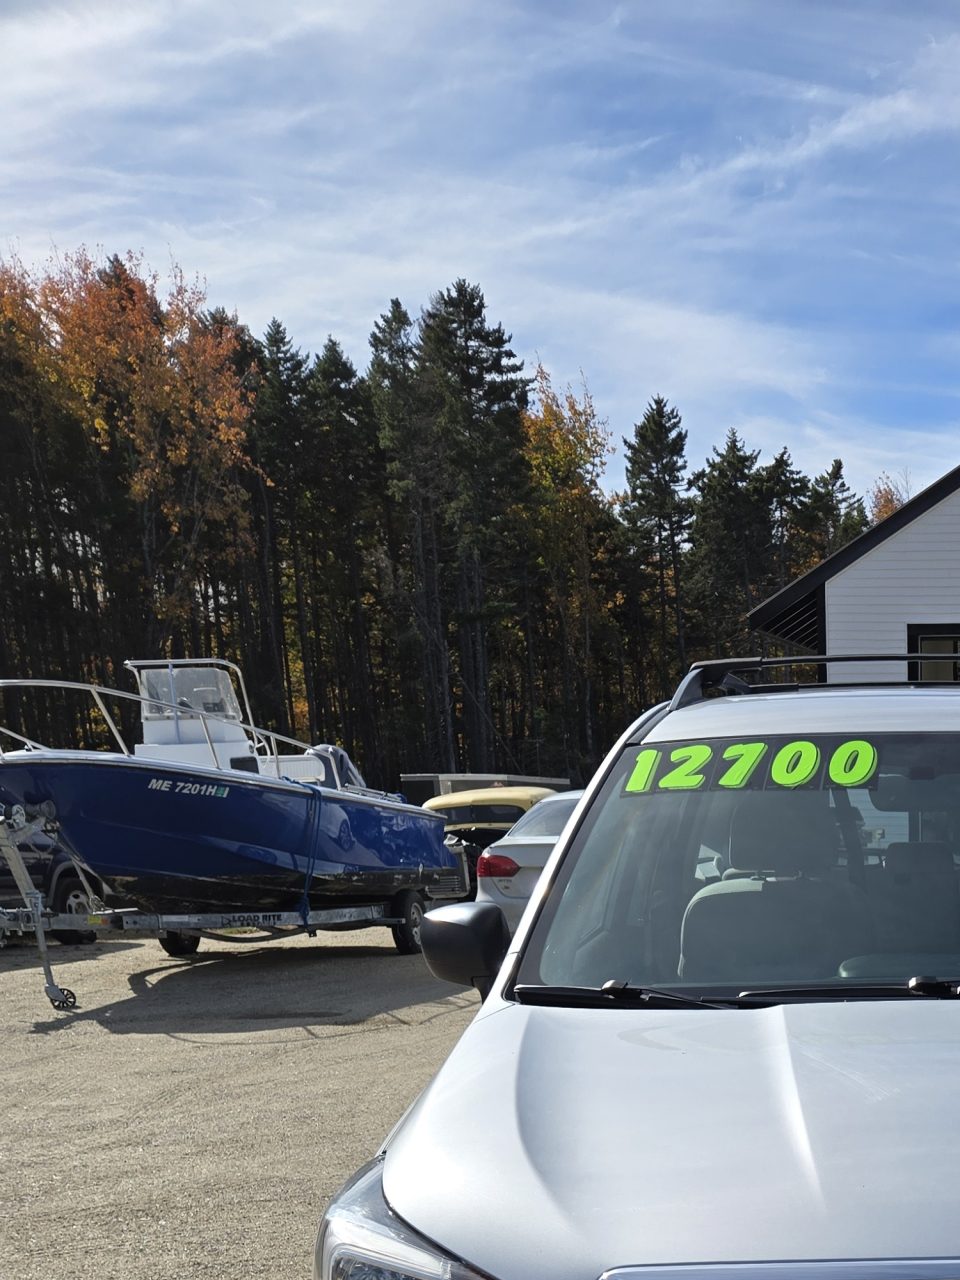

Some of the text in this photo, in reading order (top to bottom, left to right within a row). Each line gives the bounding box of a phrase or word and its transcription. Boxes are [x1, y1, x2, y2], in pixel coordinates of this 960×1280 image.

[625, 740, 878, 793] 12700
[148, 779, 172, 791] ME
[232, 914, 282, 922] LOAD RITE
